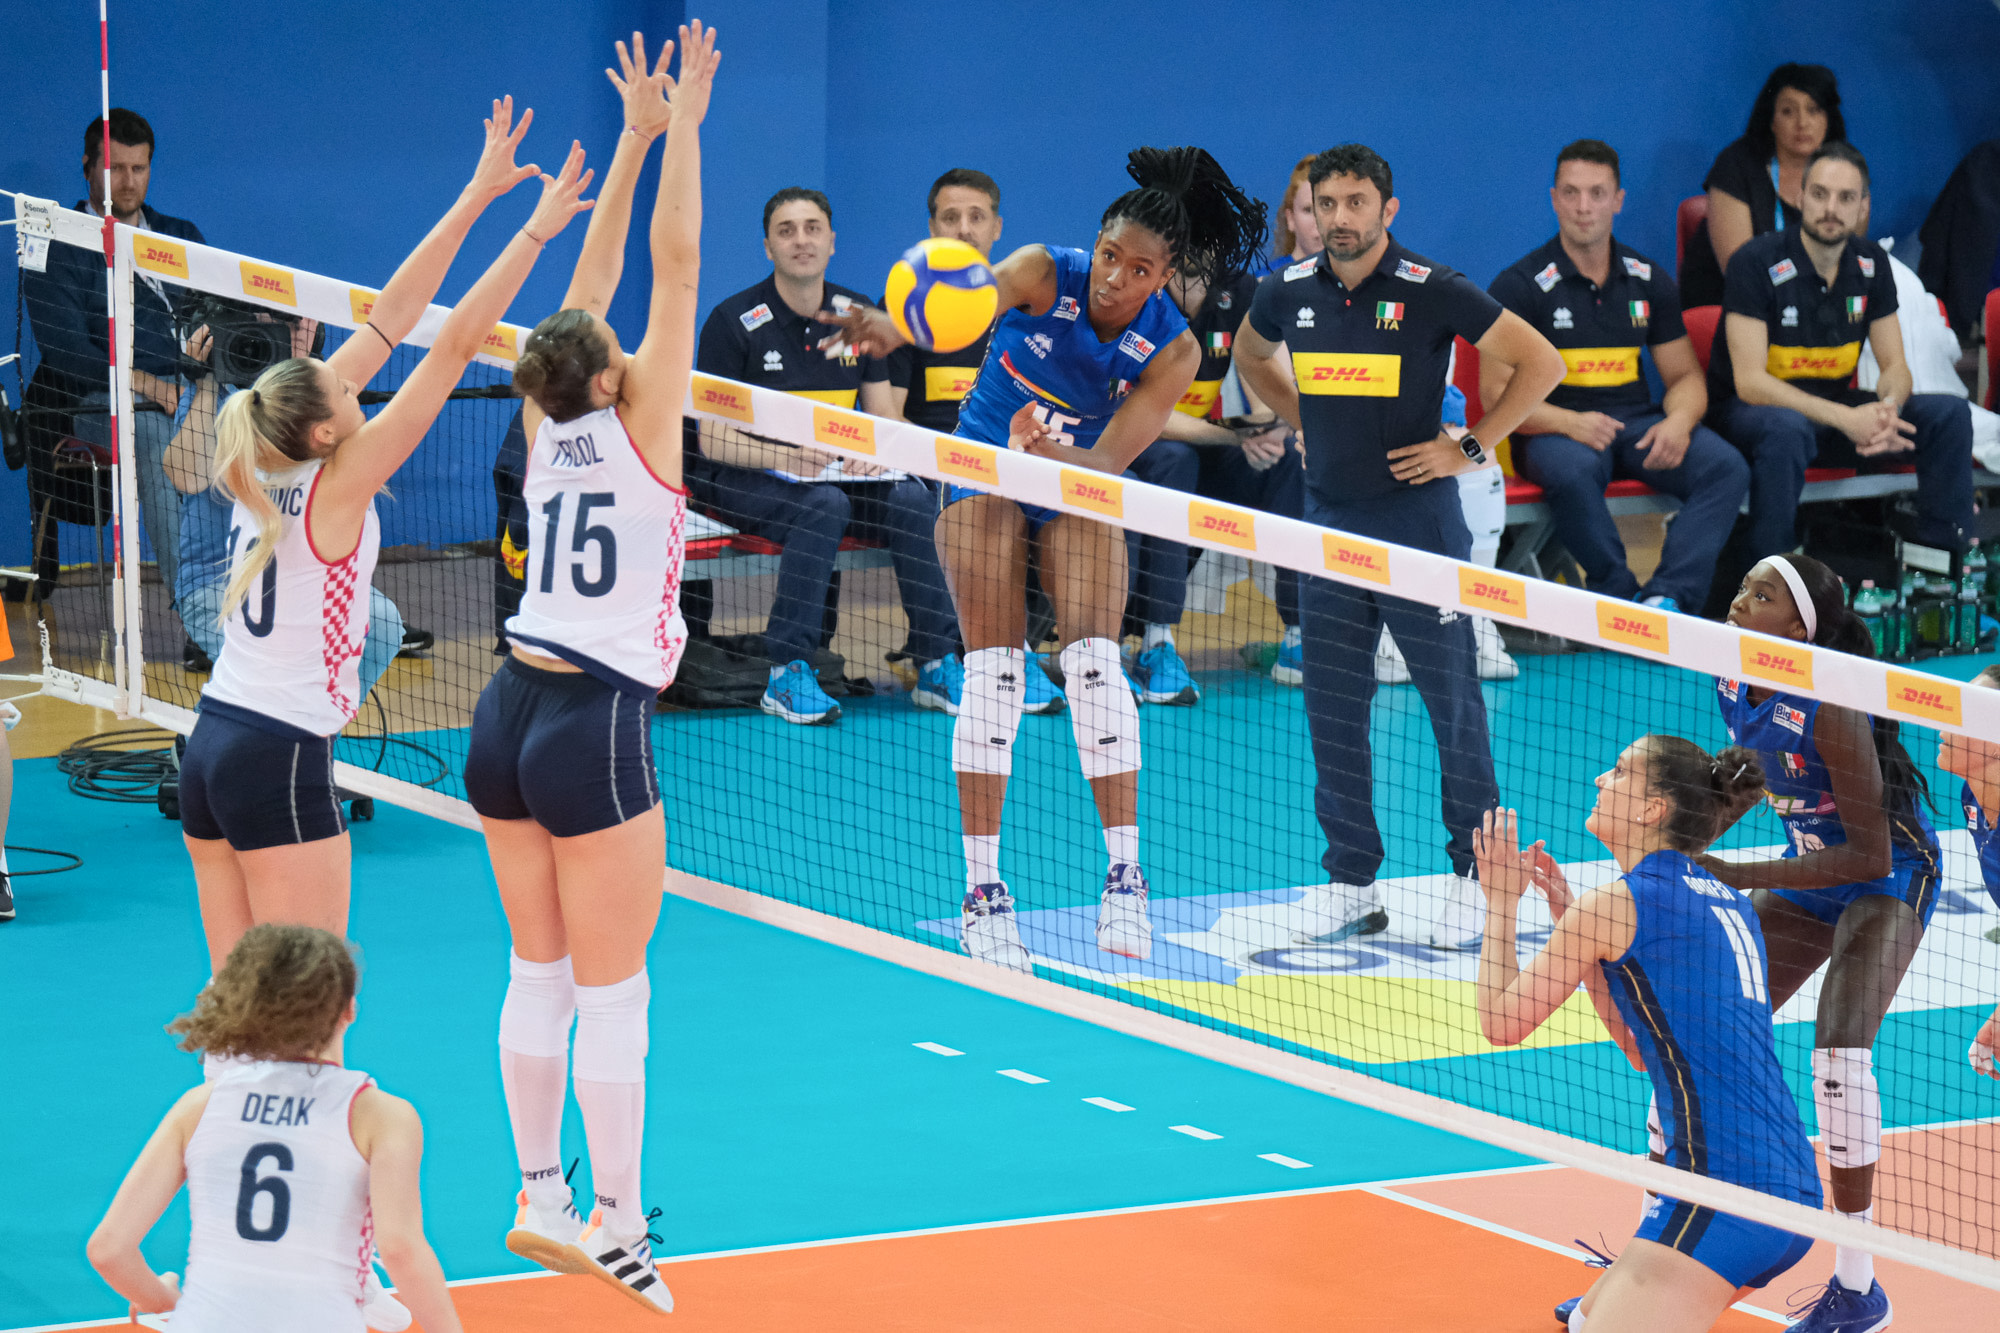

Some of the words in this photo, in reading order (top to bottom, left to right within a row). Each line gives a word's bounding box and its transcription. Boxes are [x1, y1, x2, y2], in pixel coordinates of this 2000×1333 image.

[147, 247, 177, 266] DHL
[1398, 260, 1427, 277] BigMat
[252, 275, 284, 294] DHL
[1375, 319, 1400, 331] ITA
[1023, 335, 1047, 360] errea
[1312, 367, 1371, 381] DHL
[705, 390, 739, 409] DHL
[826, 421, 861, 441] DHL
[949, 452, 984, 472] DHL
[1075, 483, 1110, 503] DHL
[1202, 515, 1241, 536] DHL
[540, 491, 617, 597] 15
[1337, 549, 1376, 569] DHL
[1473, 583, 1511, 603] DHL
[1613, 616, 1652, 638] DHL
[1757, 652, 1797, 673] DHL
[996, 684, 1016, 692] errea
[1903, 687, 1945, 709] DHL
[1710, 905, 1766, 1005] 11
[241, 1092, 316, 1127] DEAK
[525, 1163, 560, 1181] errea
[235, 1141, 295, 1242] 6
